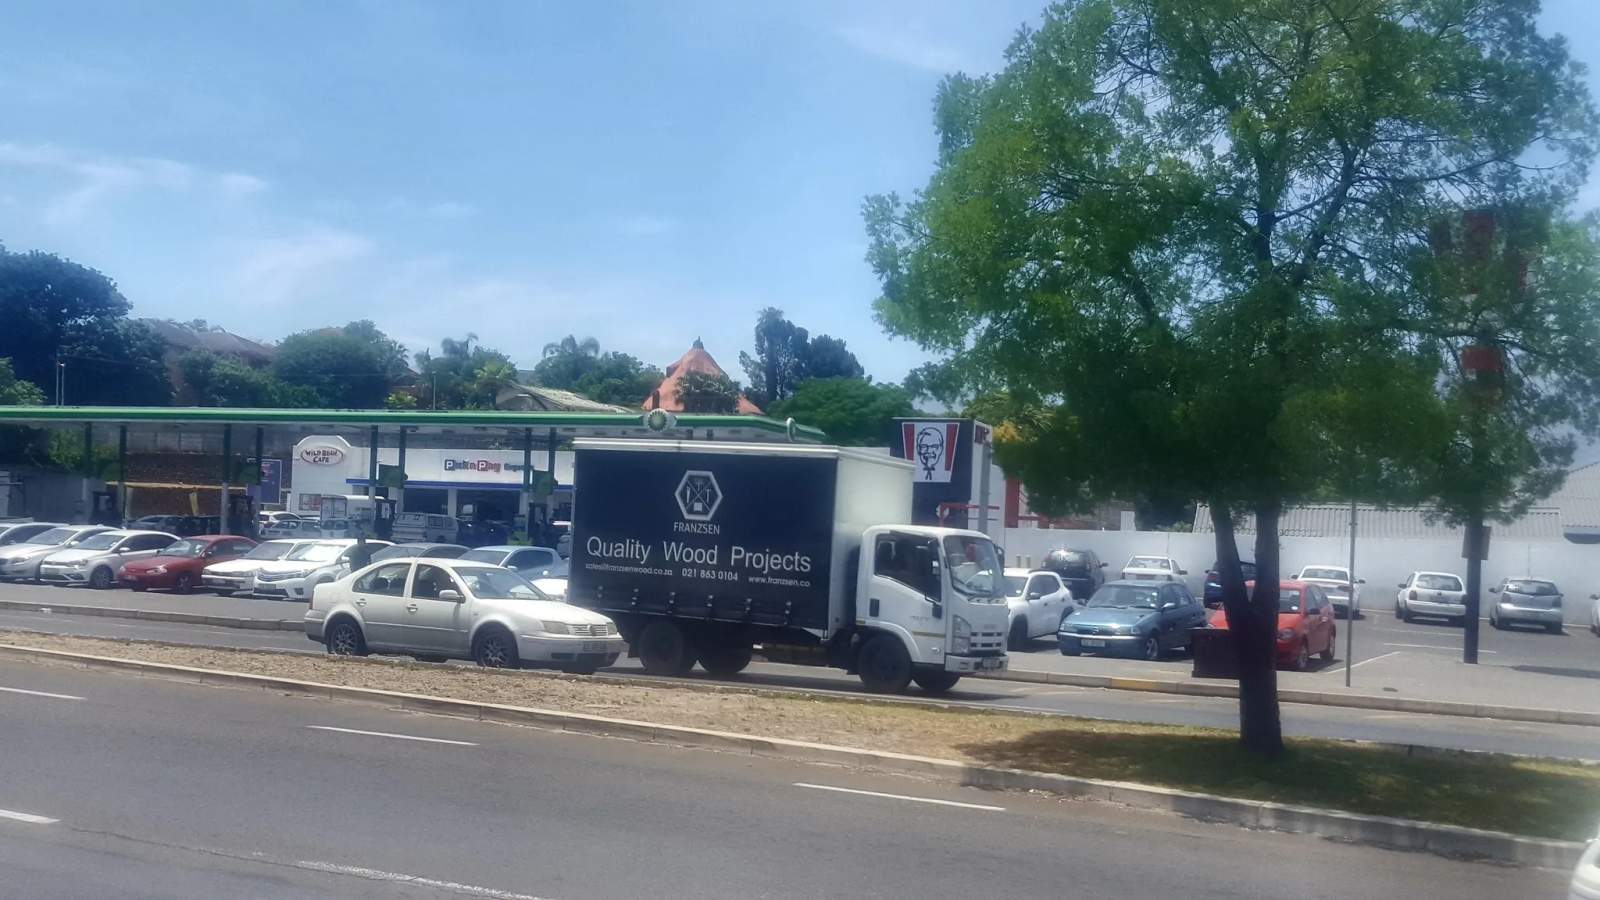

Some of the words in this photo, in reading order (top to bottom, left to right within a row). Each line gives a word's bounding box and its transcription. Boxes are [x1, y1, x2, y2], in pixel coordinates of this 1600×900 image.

[673, 521, 720, 535] FRANZSEN
[586, 536, 651, 564] Quality
[663, 540, 718, 565] Wood
[730, 545, 812, 574] Projects
[681, 567, 697, 578] 021
[700, 569, 716, 580] 863
[718, 570, 739, 581] 0104
